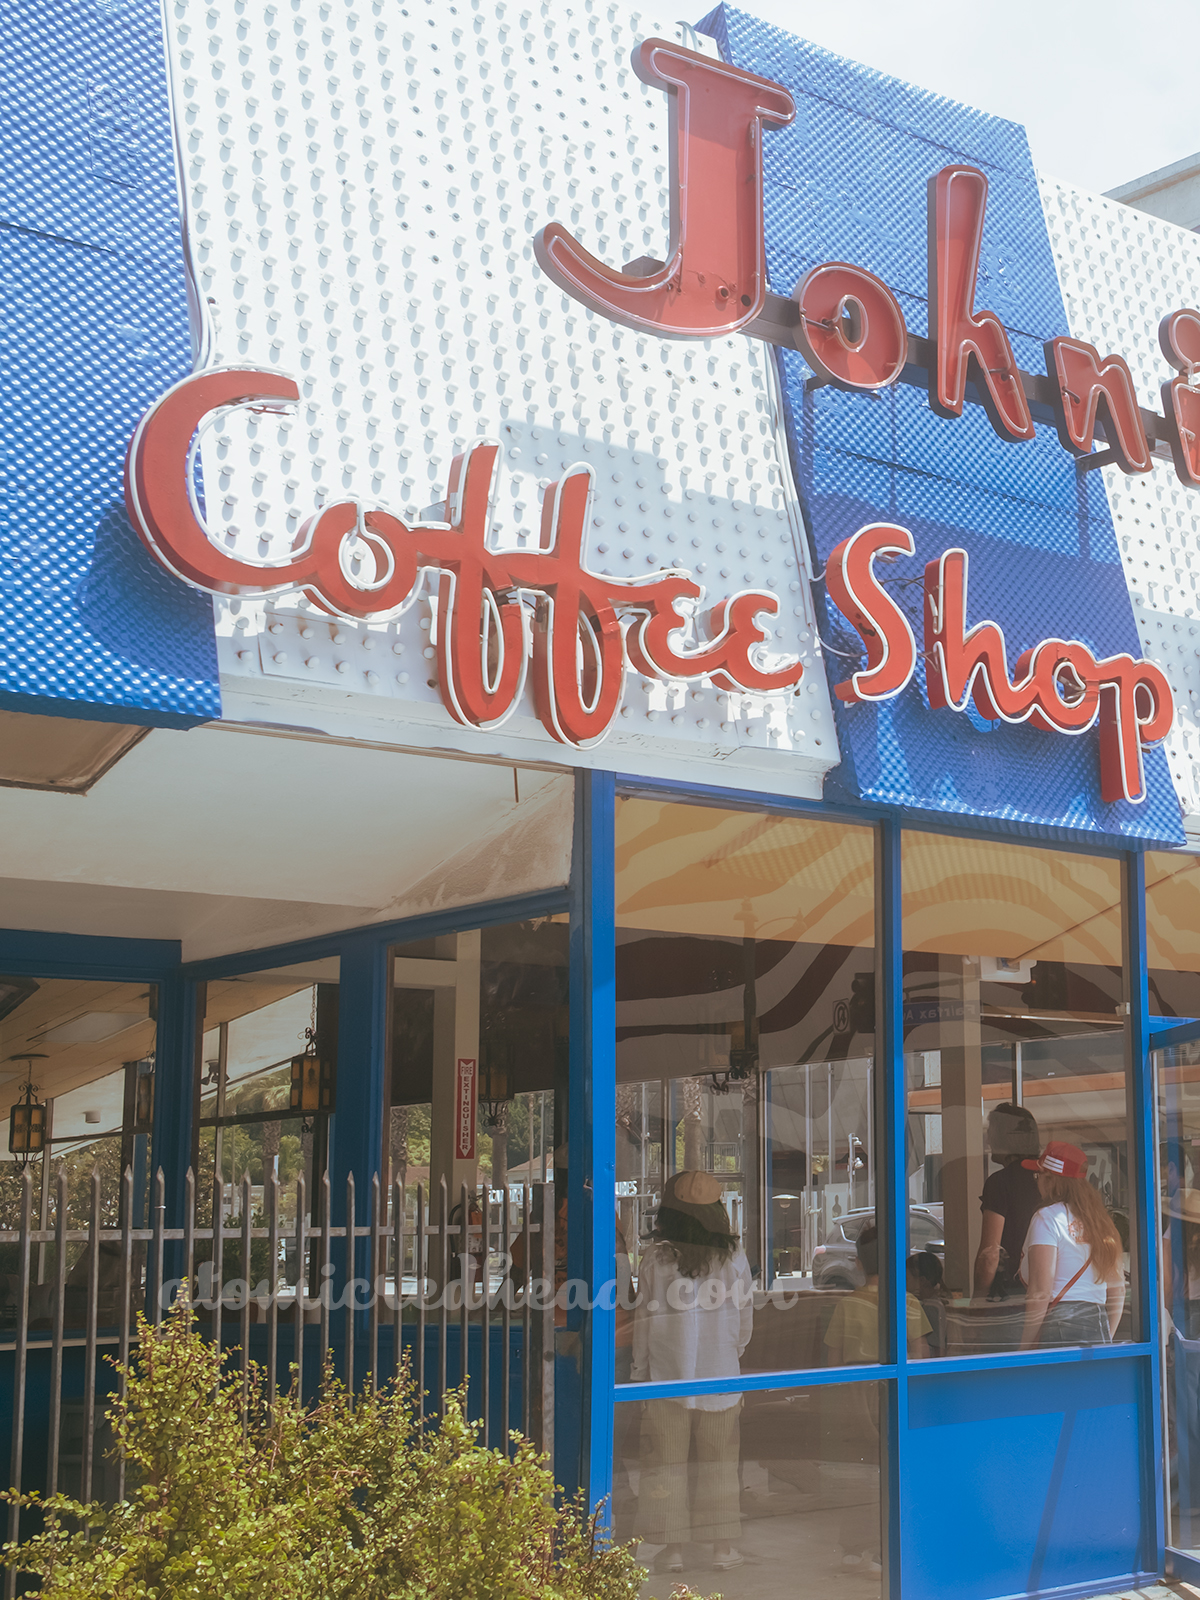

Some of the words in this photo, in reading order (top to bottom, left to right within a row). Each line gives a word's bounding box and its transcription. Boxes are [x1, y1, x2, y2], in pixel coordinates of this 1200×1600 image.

[124, 364, 804, 750] Coffee
[825, 522, 1175, 804] Shop
[461, 1066, 473, 1075] FIRE
[462, 1076, 470, 1150] EXTINGUISHER
